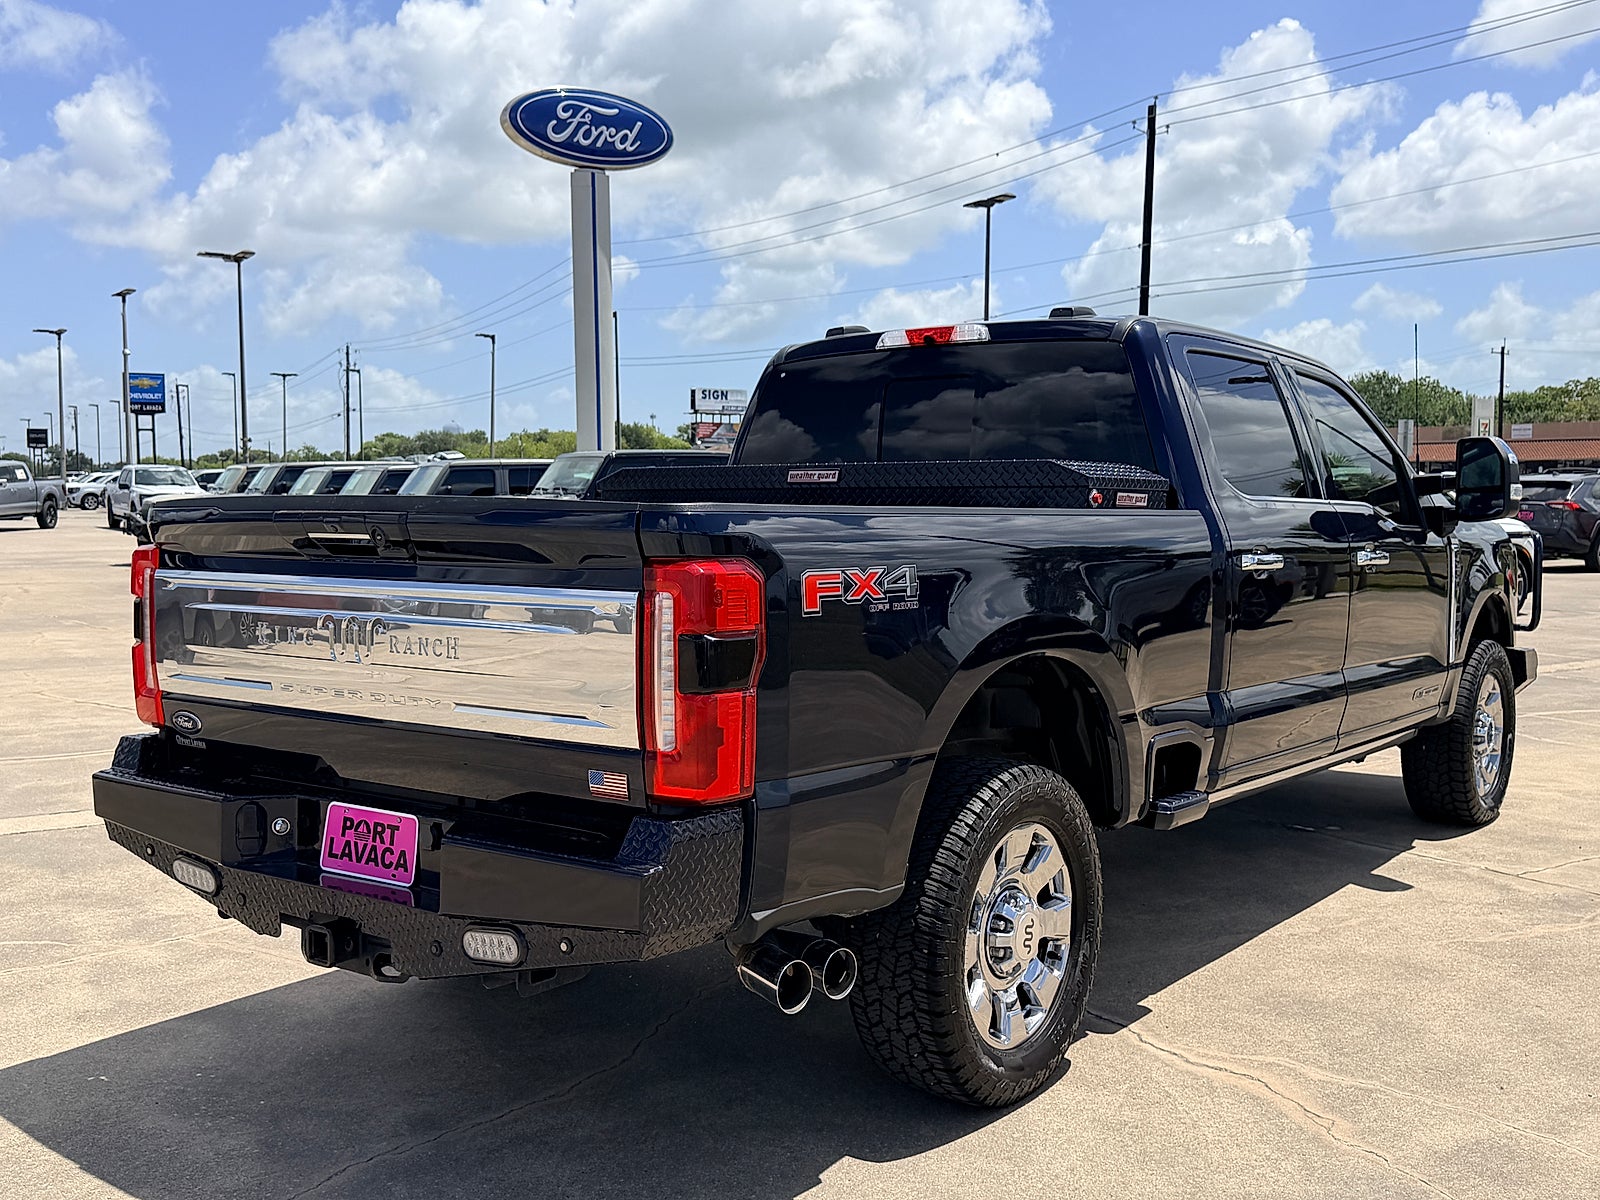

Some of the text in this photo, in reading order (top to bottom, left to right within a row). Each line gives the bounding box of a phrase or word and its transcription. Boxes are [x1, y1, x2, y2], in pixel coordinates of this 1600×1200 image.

[546, 100, 643, 152] Ford
[701, 389, 729, 401] SIGN
[789, 471, 837, 481] weather guard
[800, 564, 920, 618] FX4
[869, 600, 919, 613] OFF ROAD
[257, 620, 461, 661] KING RANCH
[279, 682, 442, 709] SUPER DUTY
[177, 715, 194, 729] Ford
[340, 815, 401, 847] PORT
[327, 836, 409, 874] LAVACA
